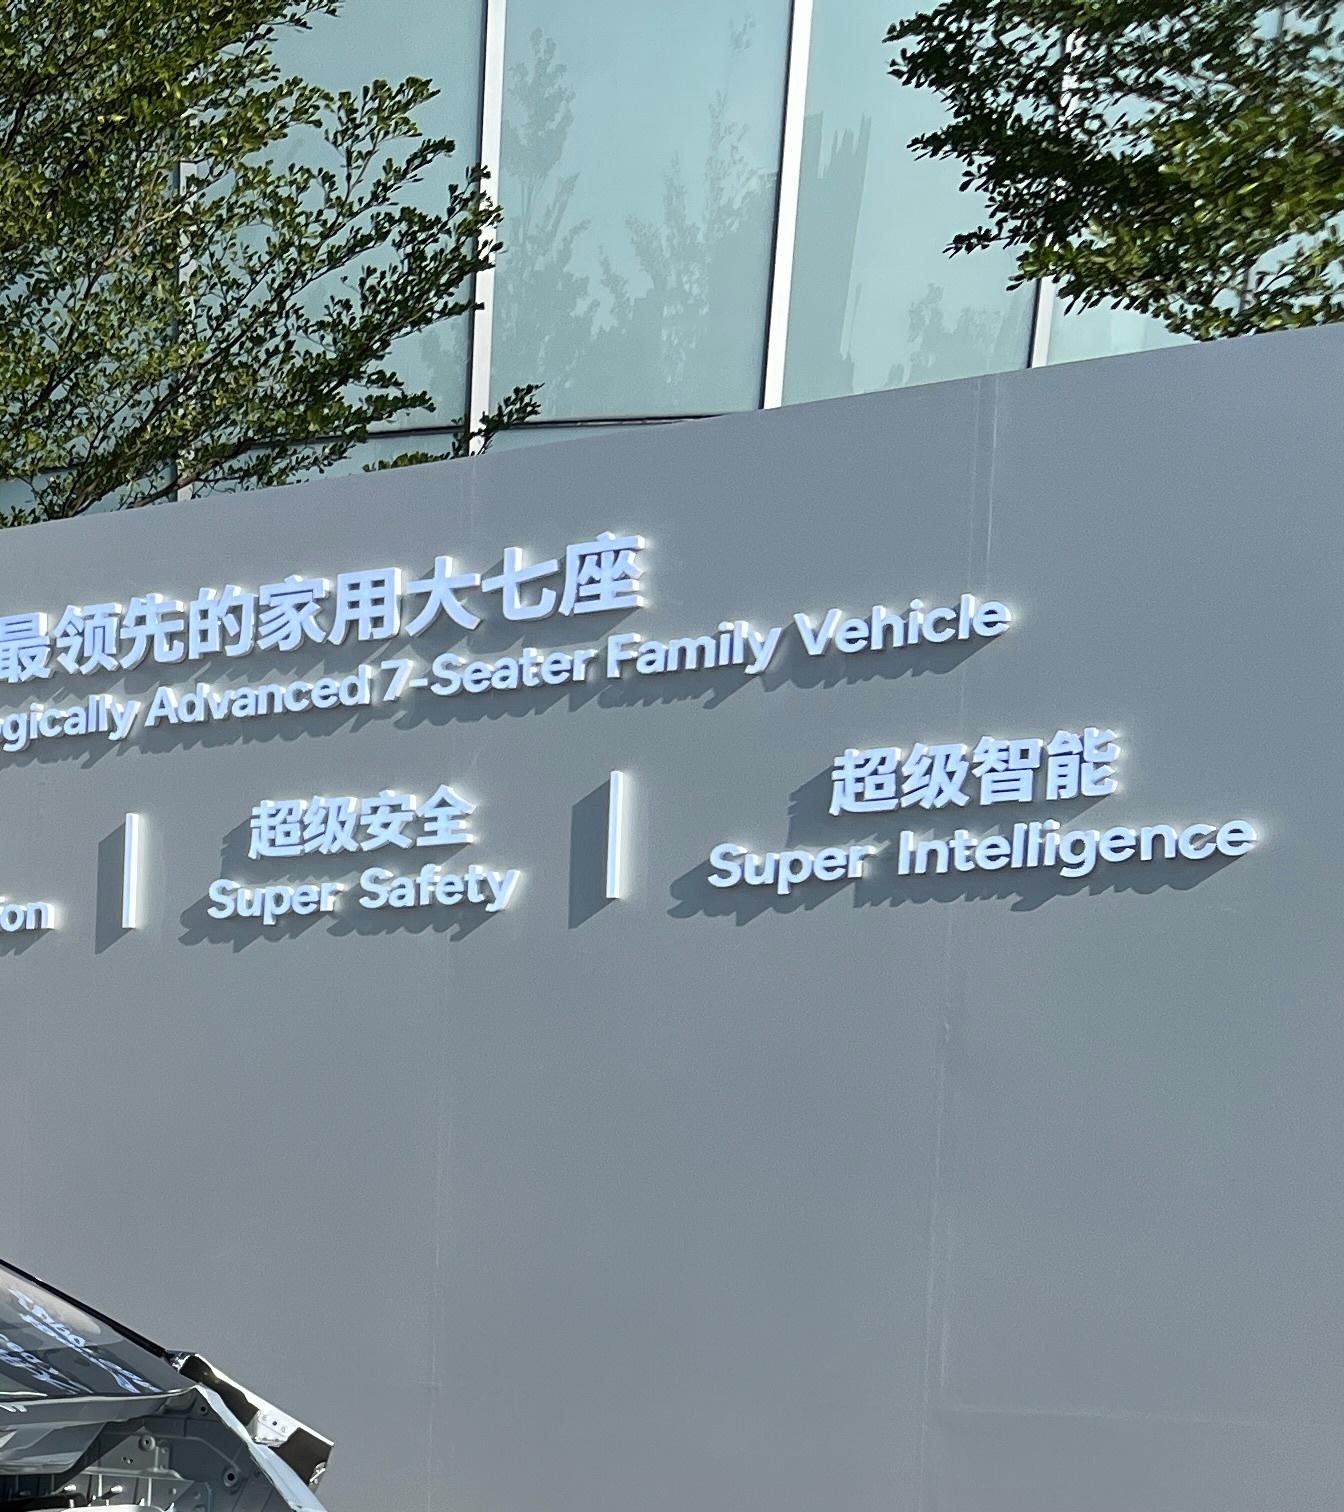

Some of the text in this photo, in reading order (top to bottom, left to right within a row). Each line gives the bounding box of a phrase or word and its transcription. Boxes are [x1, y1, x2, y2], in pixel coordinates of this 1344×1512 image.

[144, 664, 371, 727] Advanced
[380, 648, 599, 701] 7-Seater
[607, 620, 782, 677] Family
[794, 594, 1012, 656] Vehicle
[829, 727, 1120, 815] 超级智能
[248, 784, 477, 859] 超级安全
[708, 820, 1258, 895] Super Intelligence
[207, 863, 520, 925] Super Safety
